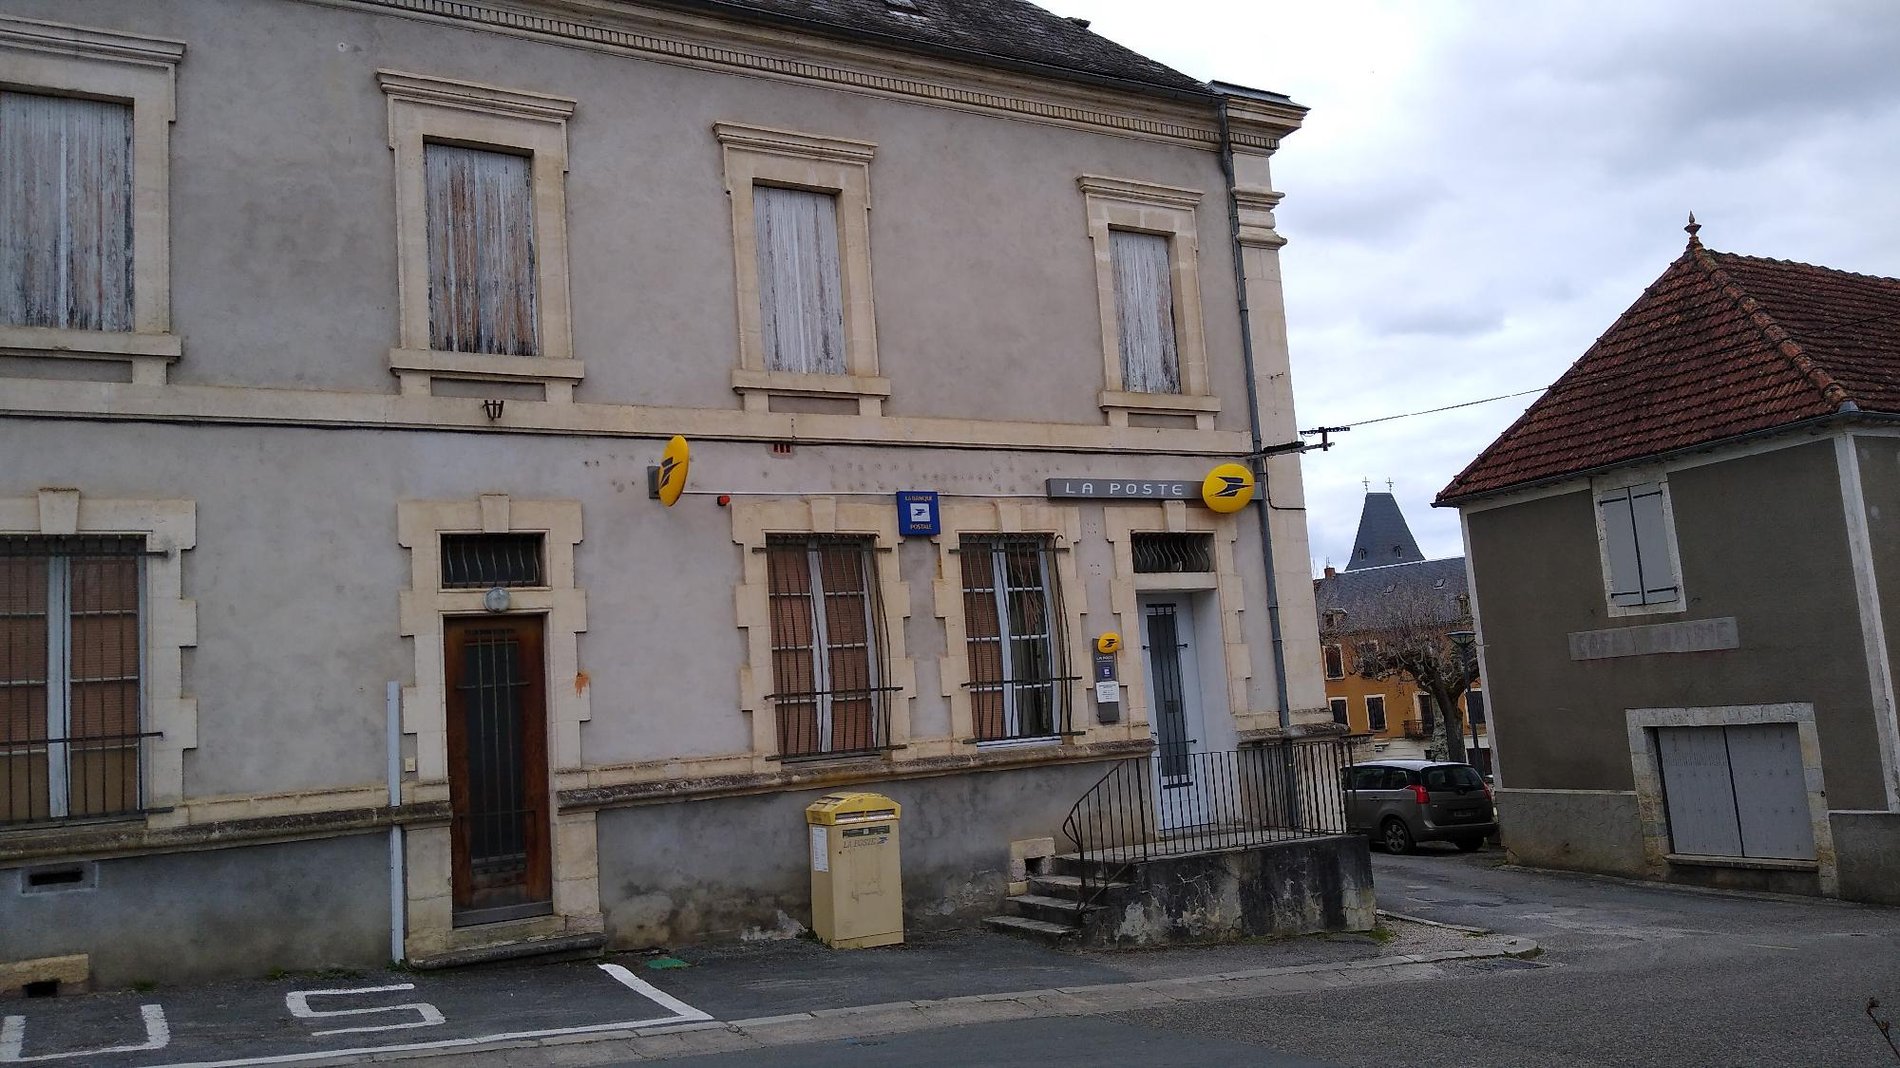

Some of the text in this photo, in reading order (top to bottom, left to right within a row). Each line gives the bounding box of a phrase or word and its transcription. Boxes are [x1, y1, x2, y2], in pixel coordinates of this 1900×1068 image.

[1065, 482, 1183, 496] LA POSTE
[853, 838, 877, 848] POSTE
